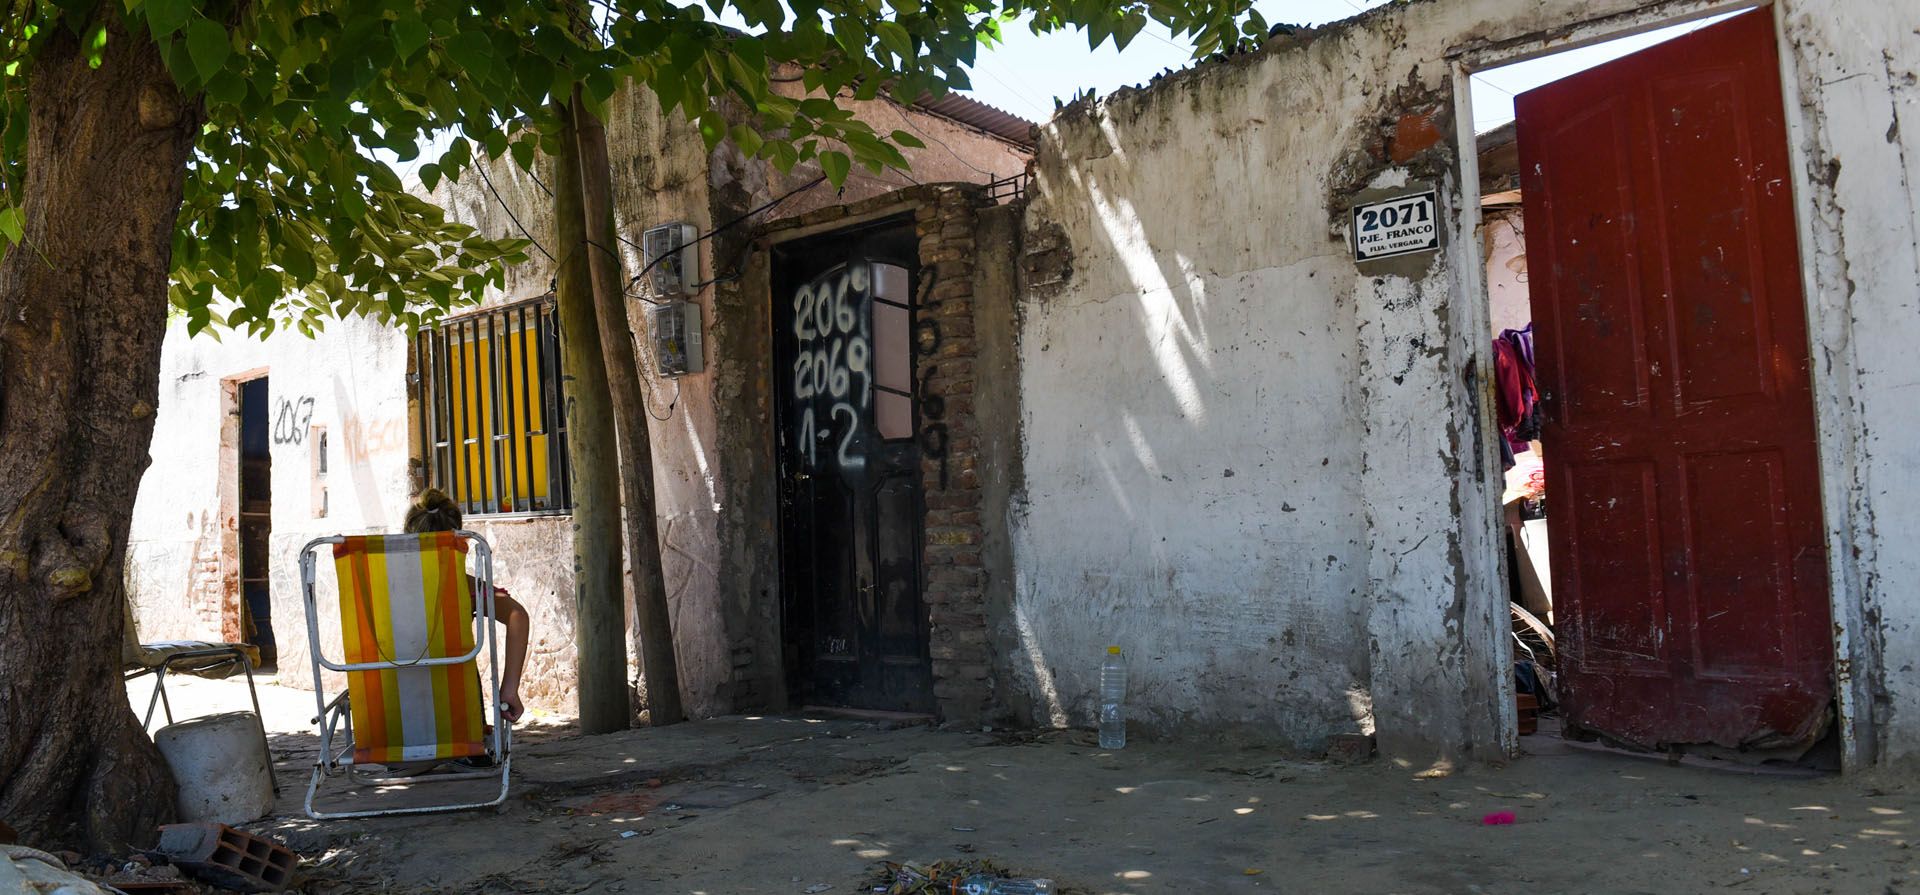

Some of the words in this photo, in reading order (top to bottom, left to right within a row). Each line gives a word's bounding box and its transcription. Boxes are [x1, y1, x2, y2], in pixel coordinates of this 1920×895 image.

[1362, 201, 1429, 232] 2071
[1360, 233, 1383, 244] PJE.
[1387, 225, 1432, 240] FRANCO
[1389, 239, 1423, 249] VERGARA
[793, 337, 870, 409] 2069
[273, 395, 316, 446] 2067
